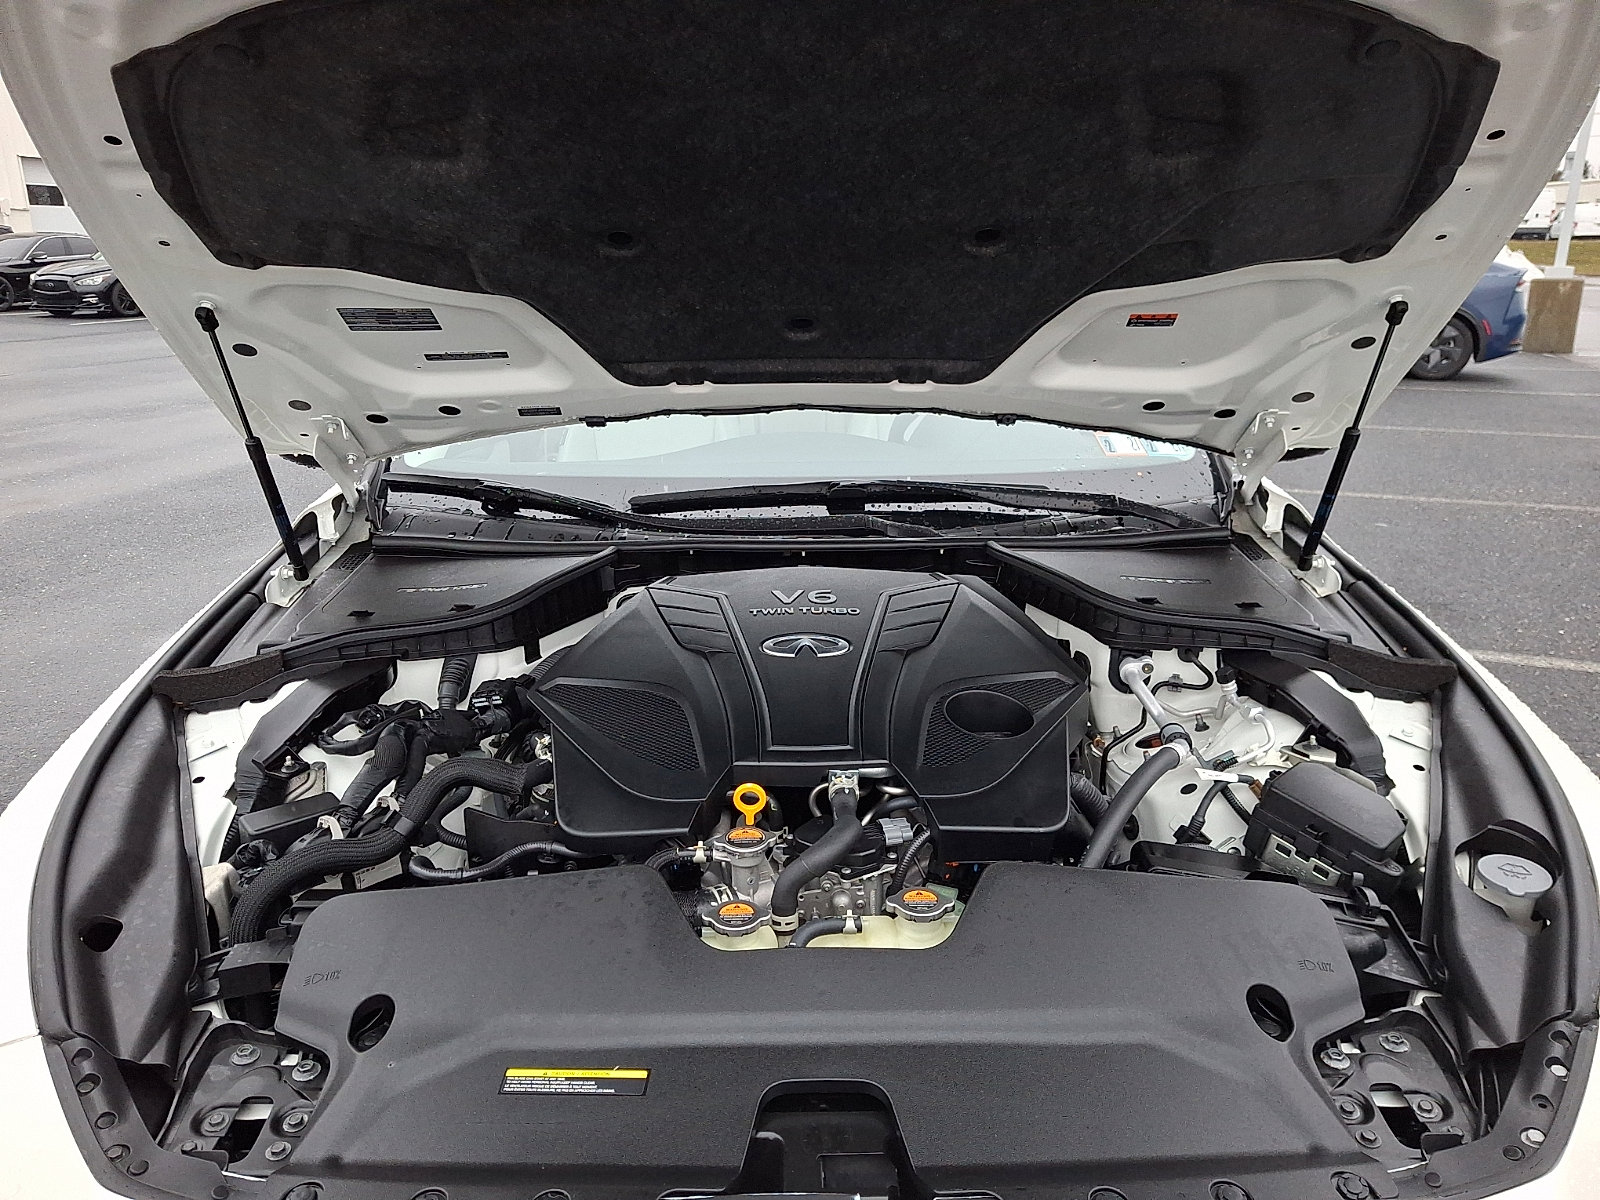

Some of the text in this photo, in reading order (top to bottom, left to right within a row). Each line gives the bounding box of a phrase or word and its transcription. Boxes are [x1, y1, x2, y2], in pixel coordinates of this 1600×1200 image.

[771, 589, 838, 604] V6
[749, 606, 861, 616] TWIN TURBO
